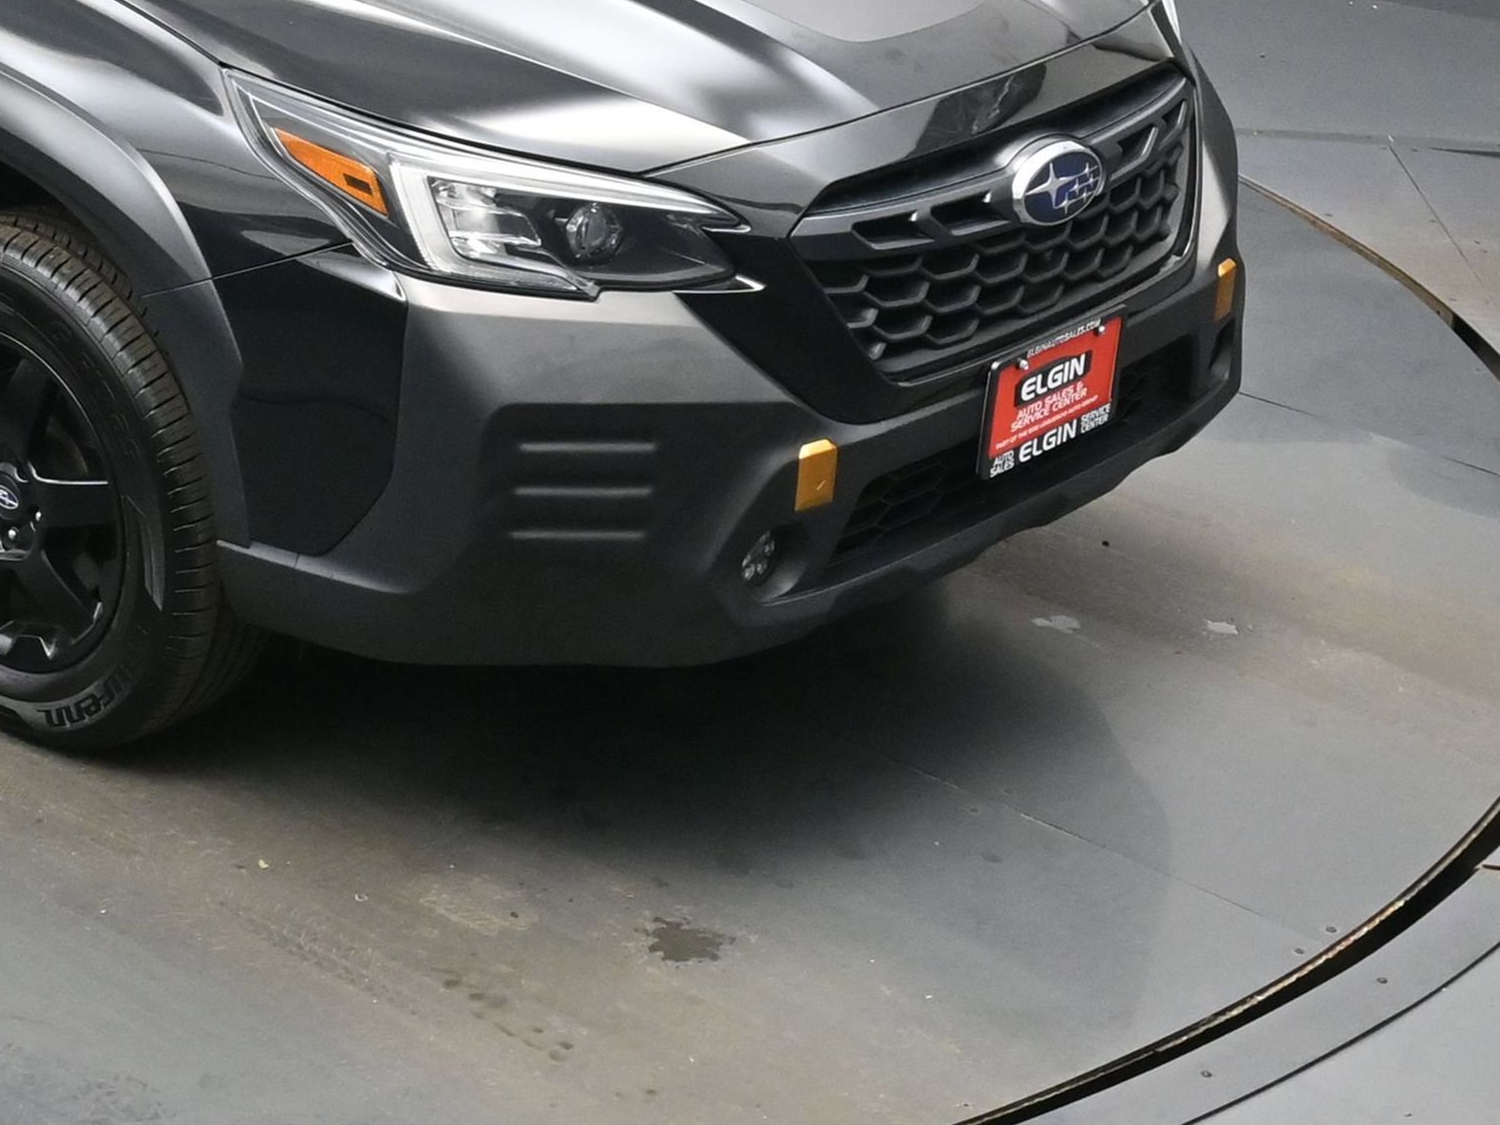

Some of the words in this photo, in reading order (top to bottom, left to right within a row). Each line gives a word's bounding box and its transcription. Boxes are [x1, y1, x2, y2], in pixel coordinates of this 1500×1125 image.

[1020, 353, 1087, 402] ELGIN
[1010, 409, 1051, 433] SERVICE
[1051, 387, 1088, 412] CENTER
[1016, 400, 1043, 421] AUTO
[1043, 384, 1075, 406] SALES
[1080, 402, 1112, 425] SERVICE
[1080, 413, 1109, 434] CENTER
[1018, 418, 1078, 463] ELGIN
[989, 459, 1016, 479] SALES
[992, 449, 1015, 467] AUTO
